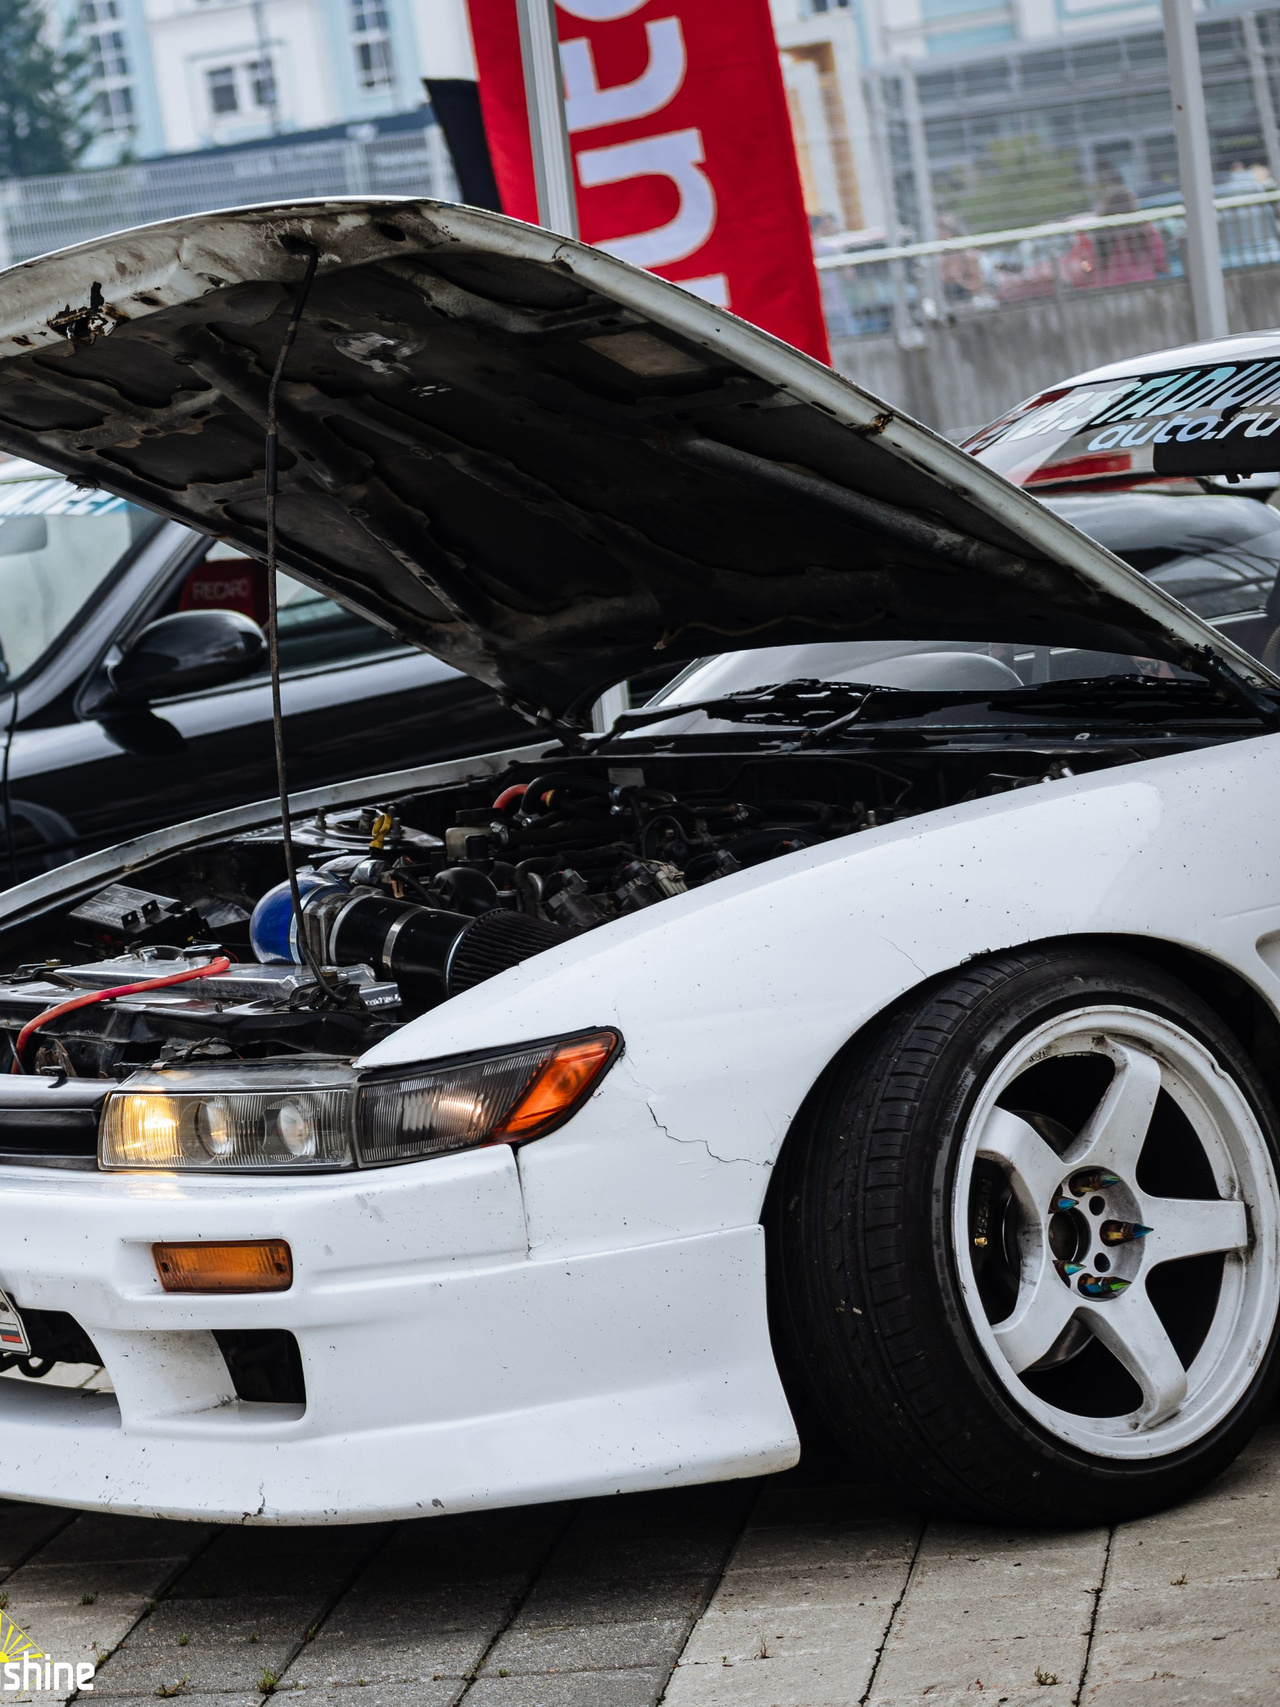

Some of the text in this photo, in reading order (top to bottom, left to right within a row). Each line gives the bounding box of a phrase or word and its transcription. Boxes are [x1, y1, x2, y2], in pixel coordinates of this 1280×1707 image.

[556, 0, 731, 308] ut
[1088, 412, 1280, 450] auto.ru
[965, 994, 1007, 1036] OUTSIDE
[974, 1179, 993, 1246] ISSAN
